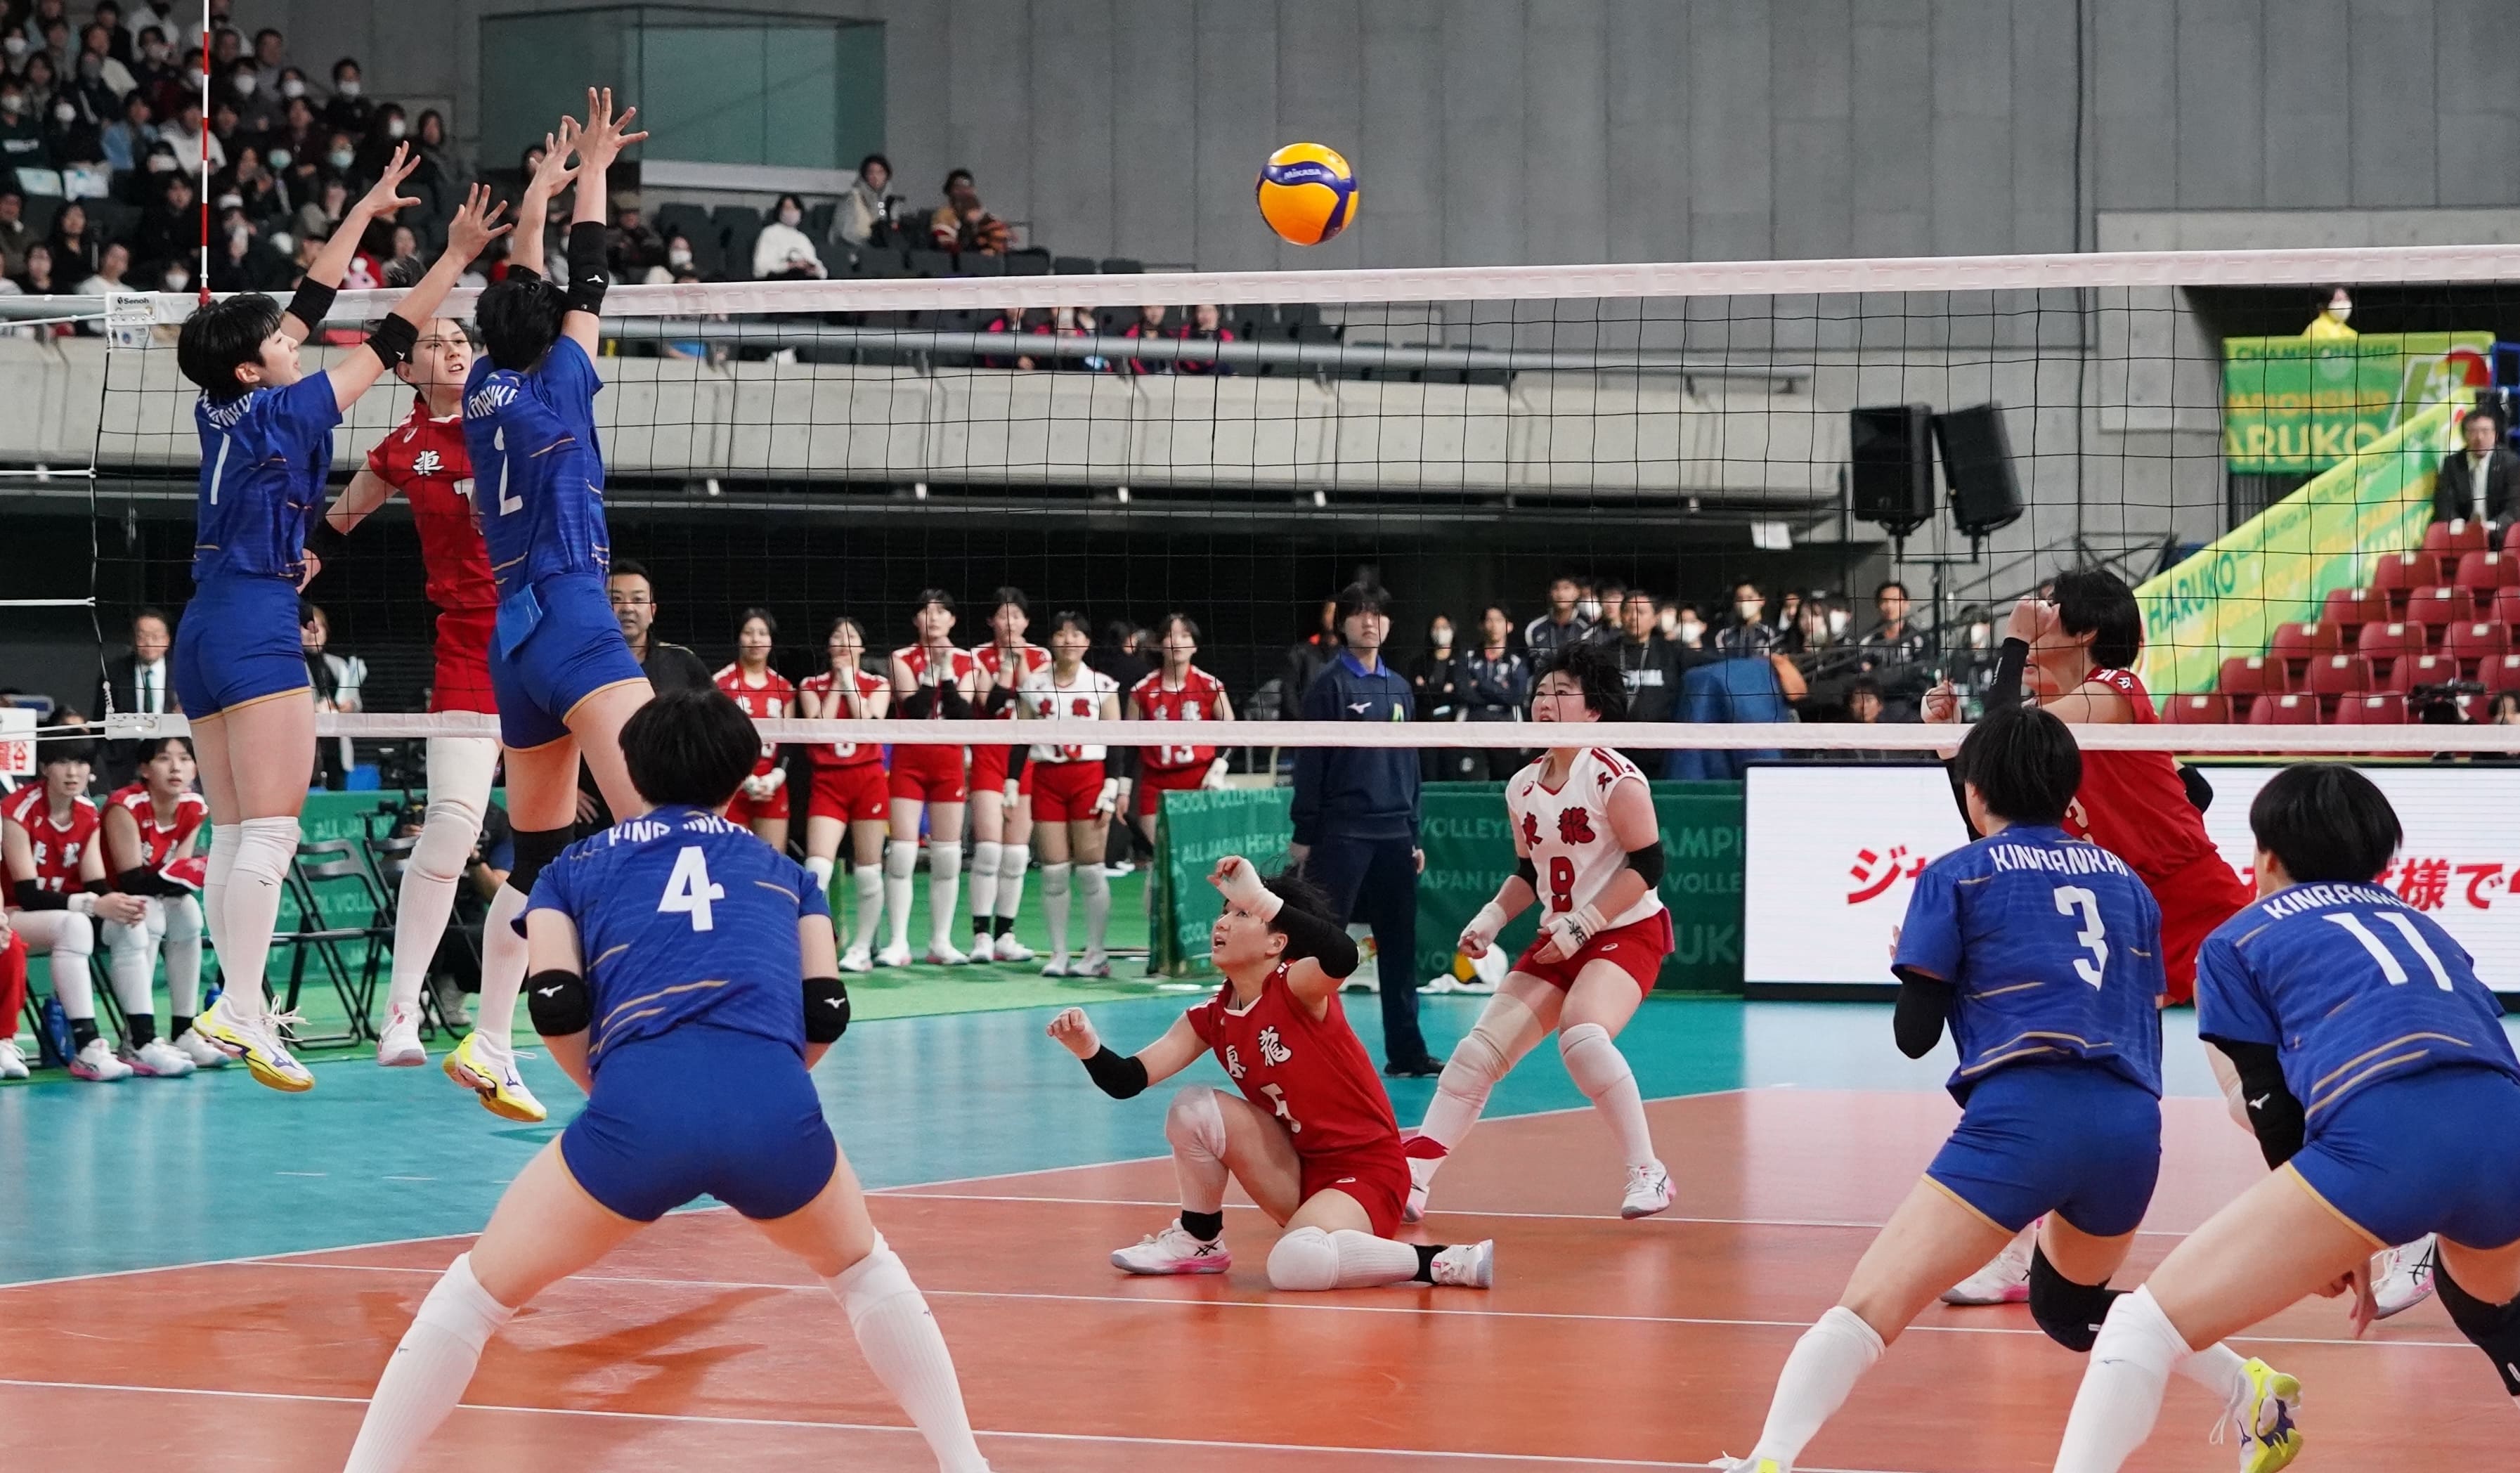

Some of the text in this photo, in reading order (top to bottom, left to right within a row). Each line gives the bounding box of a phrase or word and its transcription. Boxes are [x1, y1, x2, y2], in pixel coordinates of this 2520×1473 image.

[494, 426, 524, 517] 2
[2148, 552, 2236, 640] HARUKO
[657, 846, 725, 932] 4
[1420, 869, 1481, 891] APAN
[1550, 857, 1575, 913] 9
[2053, 885, 2109, 992] 3
[2322, 912, 2454, 992] 11
